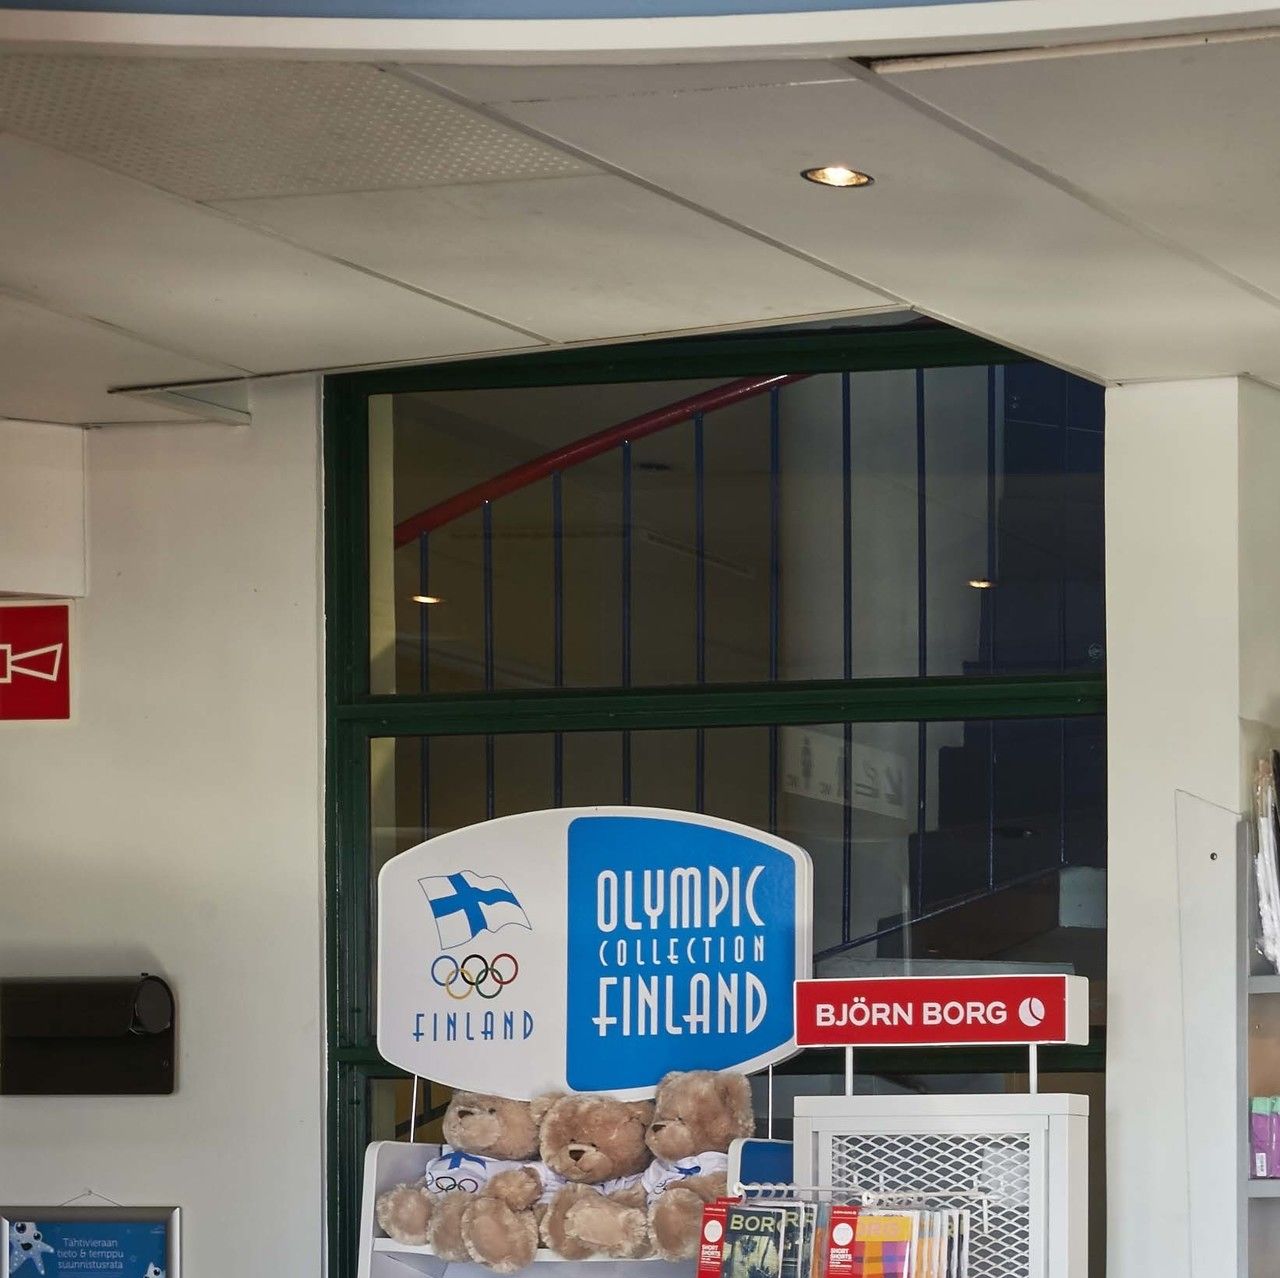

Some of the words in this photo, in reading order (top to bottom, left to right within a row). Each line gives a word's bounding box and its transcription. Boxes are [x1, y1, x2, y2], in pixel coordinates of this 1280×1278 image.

[596, 866, 766, 932] OLYMPIC
[599, 936, 765, 967] COLLECTION
[592, 971, 768, 1037] FINLAND
[816, 996, 913, 1026] BJÖRN
[922, 1001, 1007, 1025] BORG
[412, 1009, 535, 1042] FINLAND
